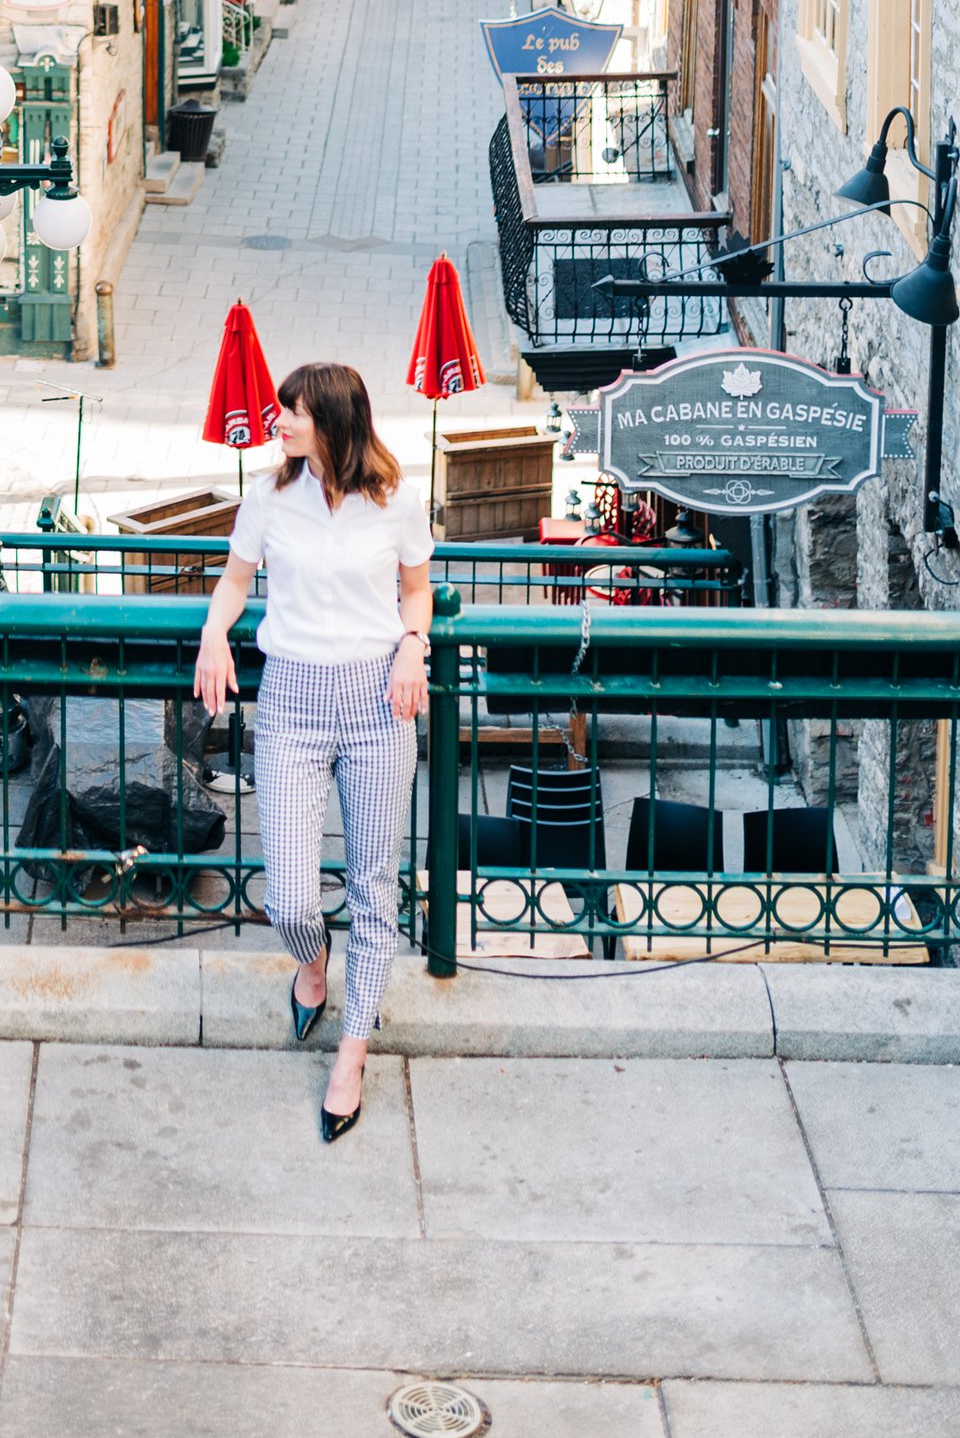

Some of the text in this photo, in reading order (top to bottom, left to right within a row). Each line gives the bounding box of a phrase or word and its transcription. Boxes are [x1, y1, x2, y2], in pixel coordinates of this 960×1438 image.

[521, 32, 580, 53] Le pub
[536, 57, 564, 74] des
[617, 401, 867, 432] MA CABANE EN GASPÉSIE
[664, 432, 817, 448] 100 % GASPÉSIEN
[676, 455, 806, 472] PRODUIT D'ÉRABLE
